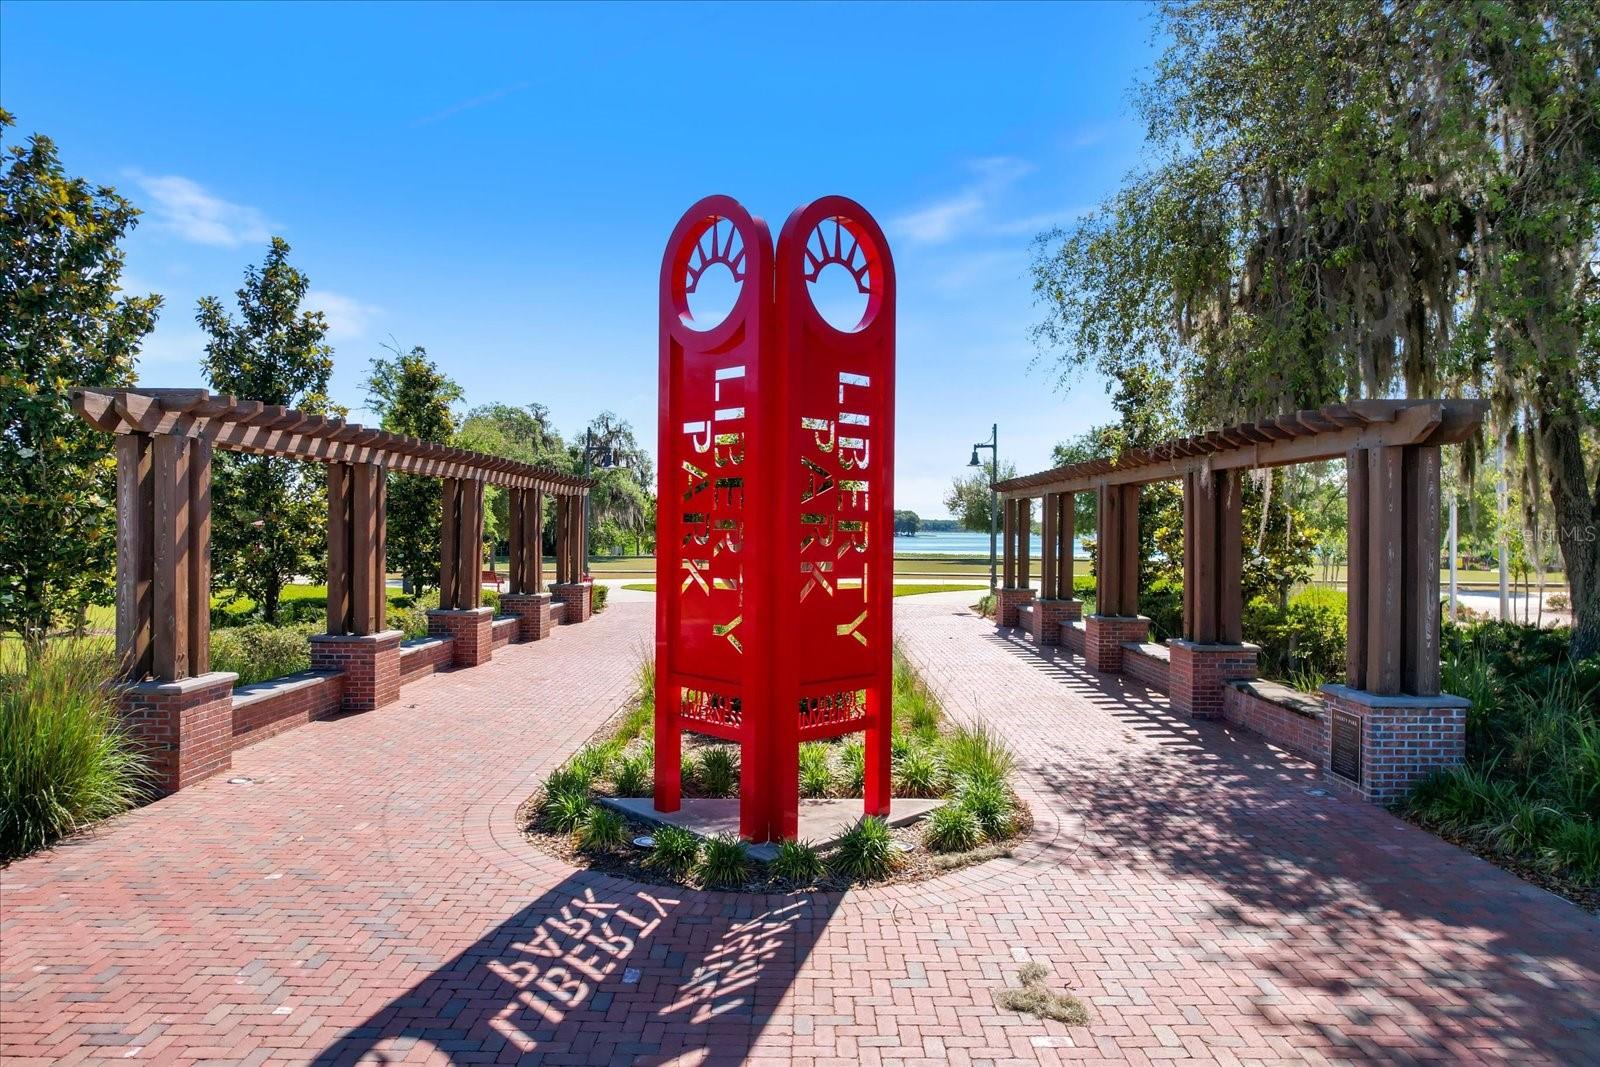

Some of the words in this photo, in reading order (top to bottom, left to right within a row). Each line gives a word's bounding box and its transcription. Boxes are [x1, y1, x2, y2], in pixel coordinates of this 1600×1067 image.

[681, 420, 711, 597] PARK
[713, 365, 745, 654] LIBERTY
[800, 416, 834, 604] PARK
[837, 371, 869, 647] LIBERTY
